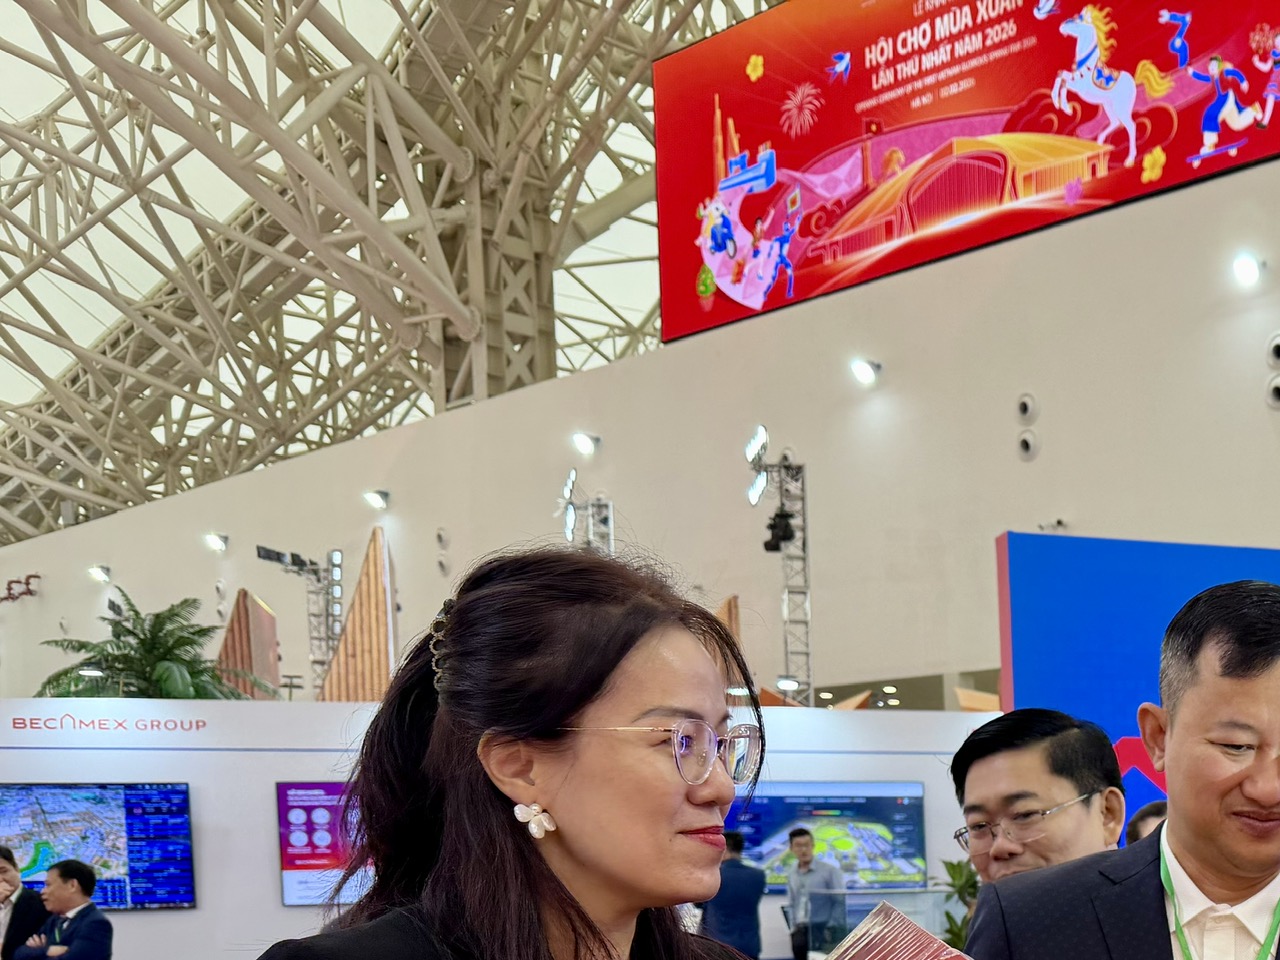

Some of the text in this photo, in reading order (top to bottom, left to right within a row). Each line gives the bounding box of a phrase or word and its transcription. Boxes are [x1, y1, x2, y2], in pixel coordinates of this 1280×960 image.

[865, 37, 894, 69] HỘI
[896, 20, 931, 55] CHỢ
[935, 5, 973, 41] MÙA
[872, 65, 894, 90] LẦN
[922, 40, 953, 72] NHẤT
[954, 30, 983, 58] NĂM
[984, 18, 1018, 46] 2026
[12, 713, 207, 731] BECAMEX GROUP
